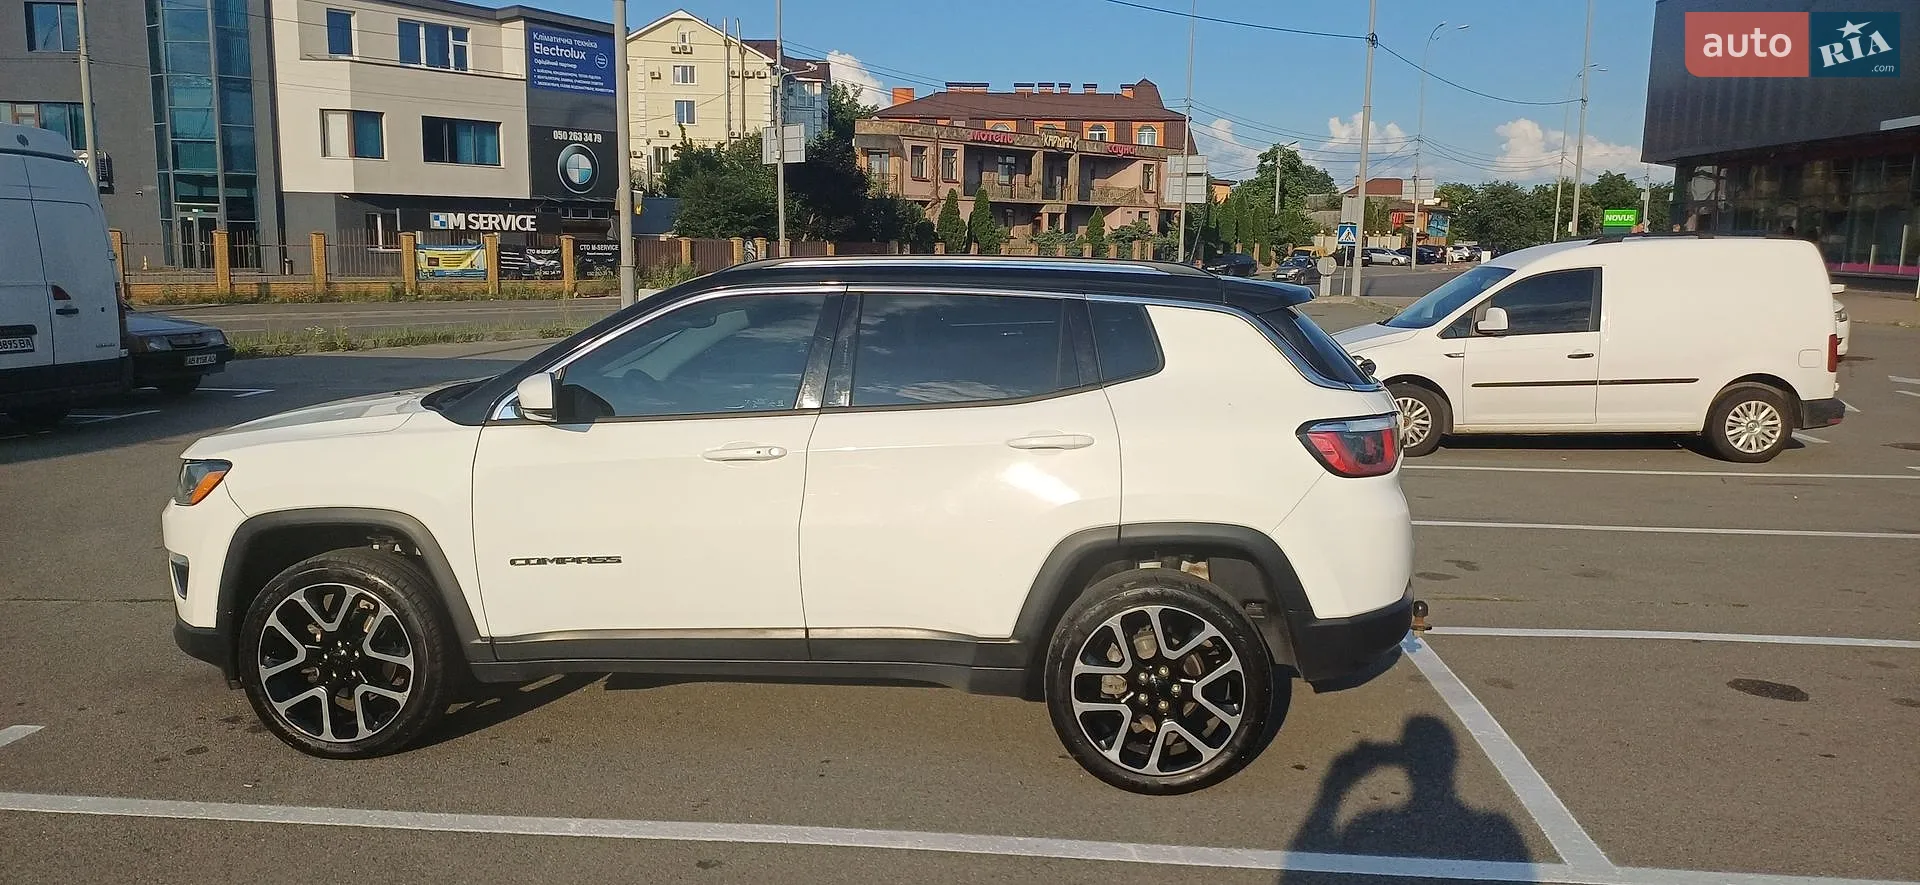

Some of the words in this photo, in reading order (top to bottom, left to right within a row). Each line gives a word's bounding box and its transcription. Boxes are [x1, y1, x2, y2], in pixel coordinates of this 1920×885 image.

[532, 31, 573, 45] Кліматична
[533, 42, 586, 60] Electrolux
[553, 130, 568, 140] 050
[568, 131, 582, 142] 263
[448, 213, 466, 230] M
[467, 213, 537, 231] SERVICE
[1605, 214, 1634, 222] NOVUS
[509, 555, 622, 566] COMPASS
